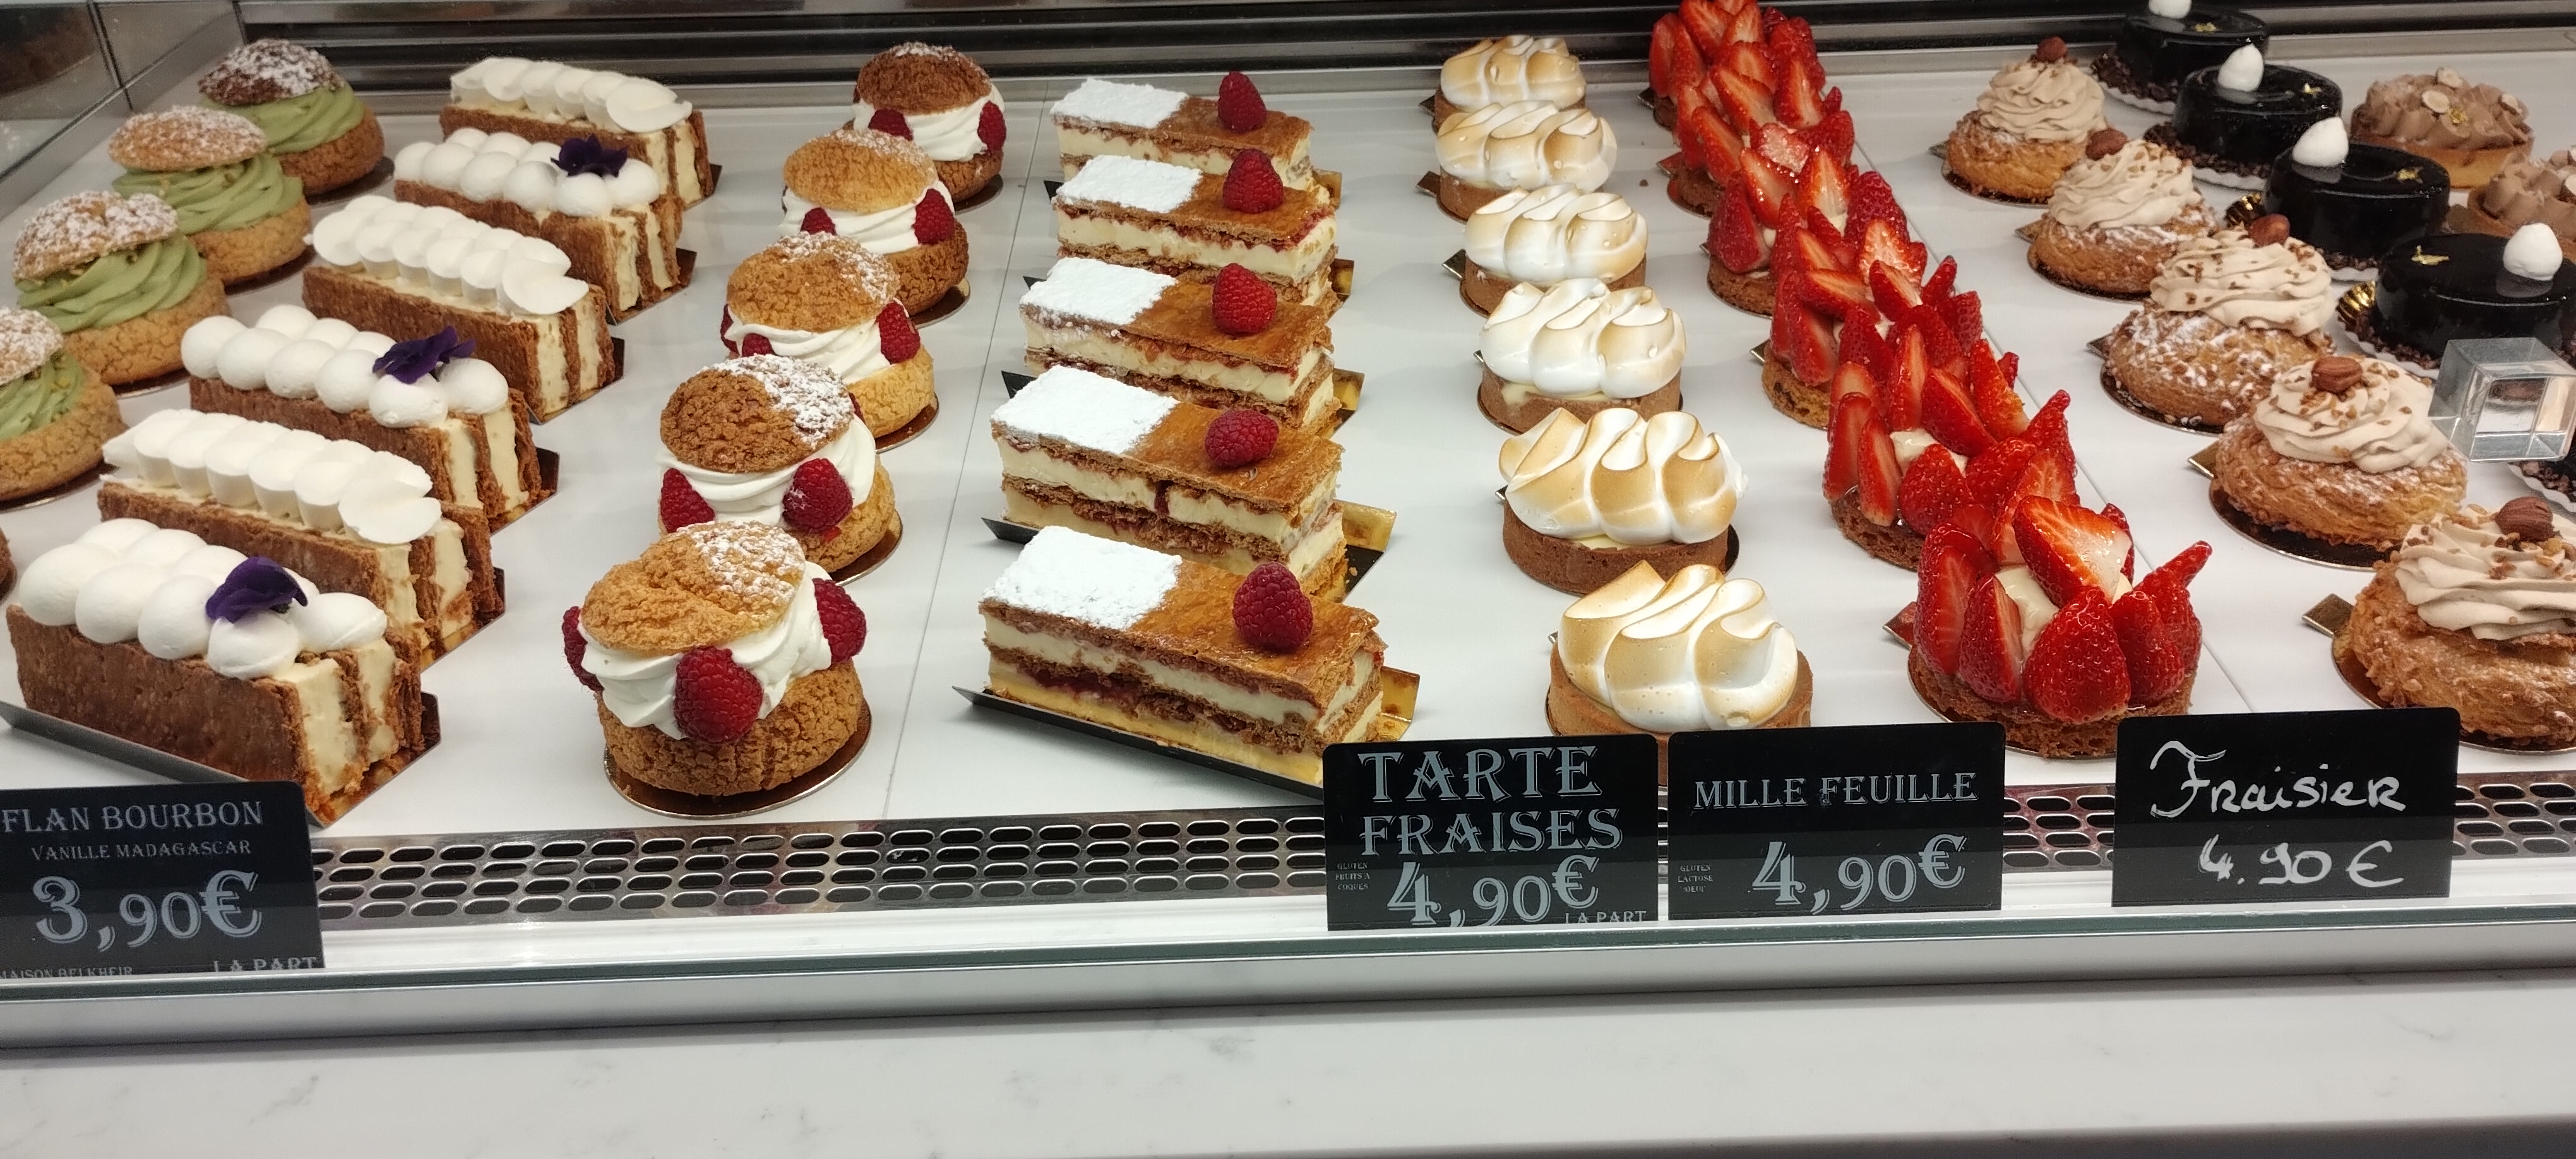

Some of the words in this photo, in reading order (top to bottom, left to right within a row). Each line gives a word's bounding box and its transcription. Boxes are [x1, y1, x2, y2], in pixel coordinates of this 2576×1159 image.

[1357, 746, 1602, 803] TARTE
[1693, 777, 1809, 810] MILLE
[1819, 771, 1979, 805] FEUILLE
[1, 807, 89, 833] FLAN
[102, 800, 263, 831] BOURBON
[1359, 809, 1624, 855] FRAISES
[32, 844, 110, 862] VANILLE
[117, 840, 251, 859] MADAGASCAR
[1337, 862, 1368, 870] GLUTEN
[1335, 872, 1363, 881] FRUITS
[1338, 883, 1369, 891] COQUES
[1386, 854, 1599, 927] 4,90€
[1751, 833, 1967, 915] 4,90€
[33, 870, 263, 953] 3,90€
[1597, 910, 1647, 924] PART
[253, 956, 317, 971] PART
